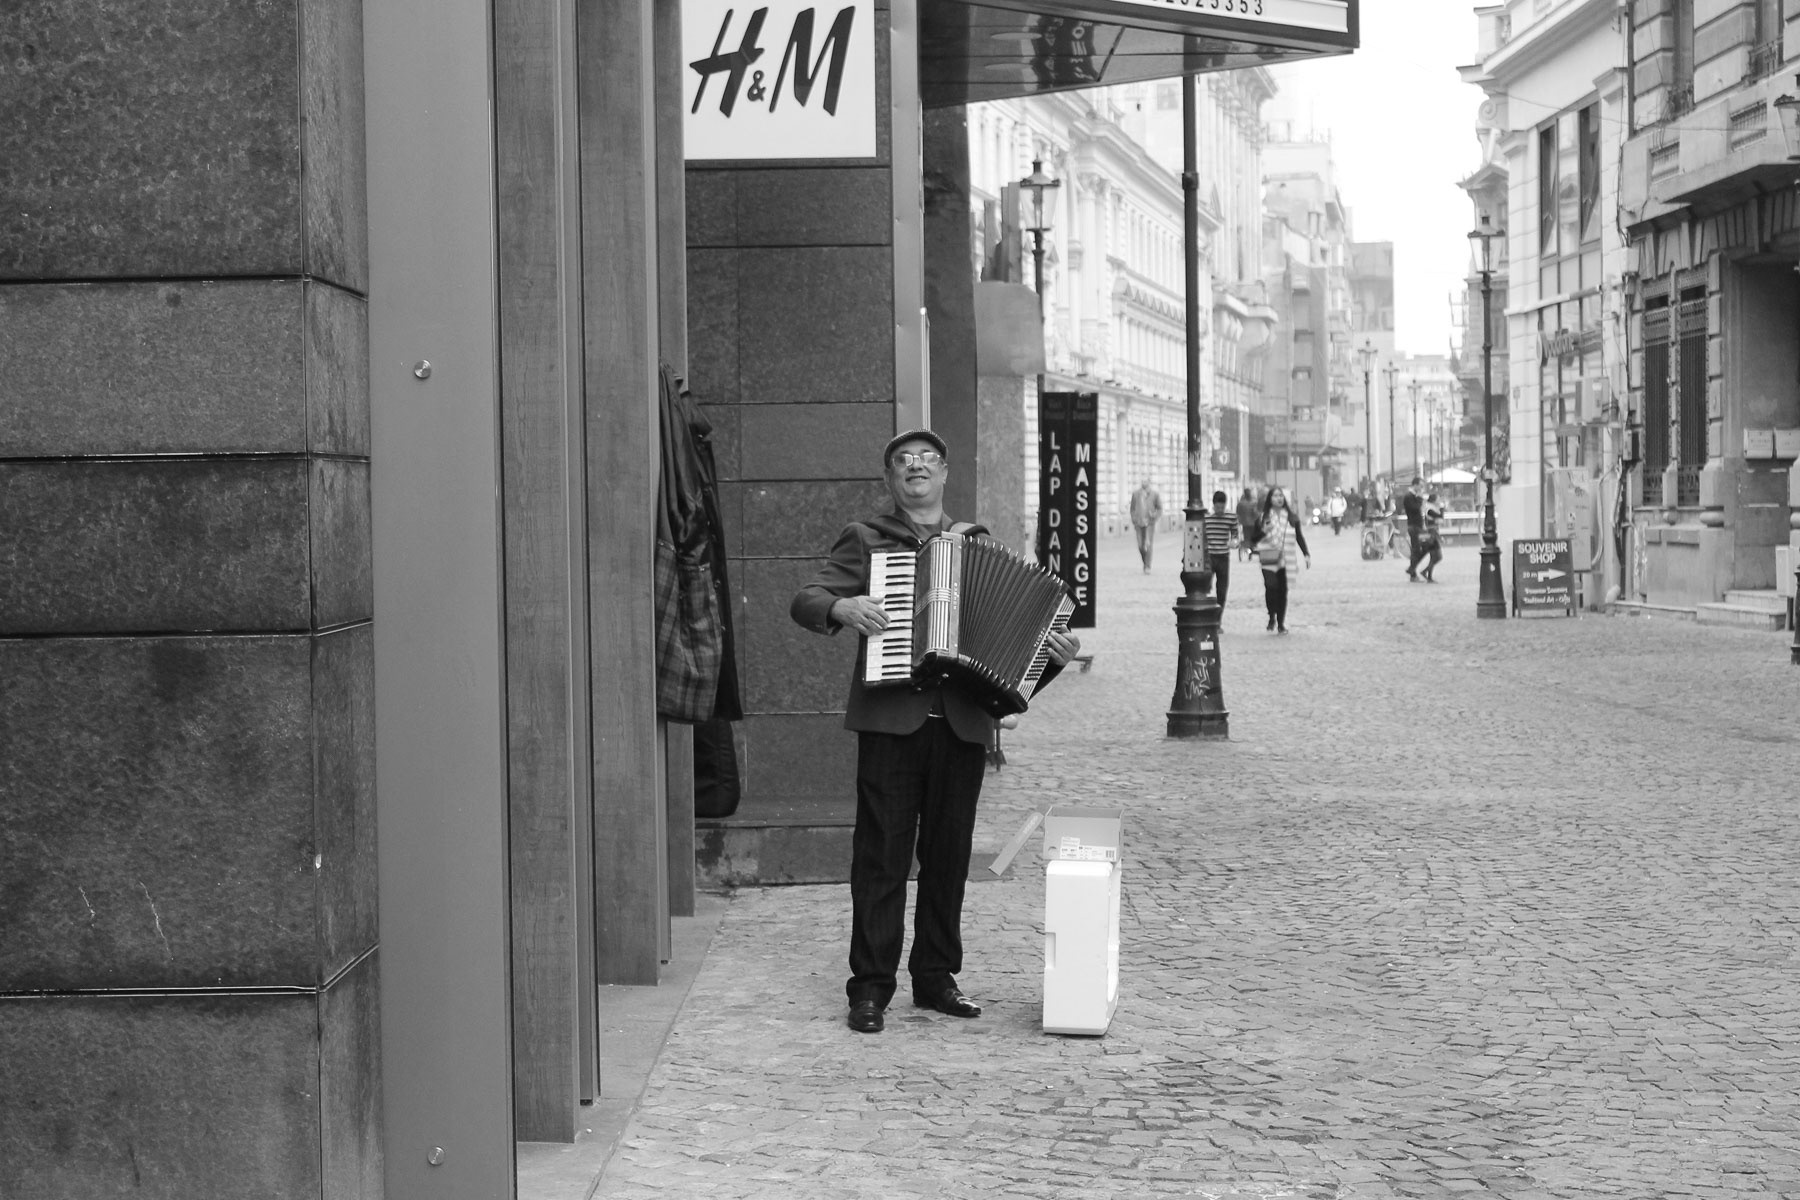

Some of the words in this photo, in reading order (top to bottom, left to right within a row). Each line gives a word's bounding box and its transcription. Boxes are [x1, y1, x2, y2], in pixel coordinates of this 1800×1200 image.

[689, 6, 856, 119] H&M
[1050, 431, 1061, 496] LAP
[1074, 443, 1090, 606] MASSAGE
[1518, 542, 1568, 554] SOUVENIR
[1530, 553, 1556, 564] SHOP
